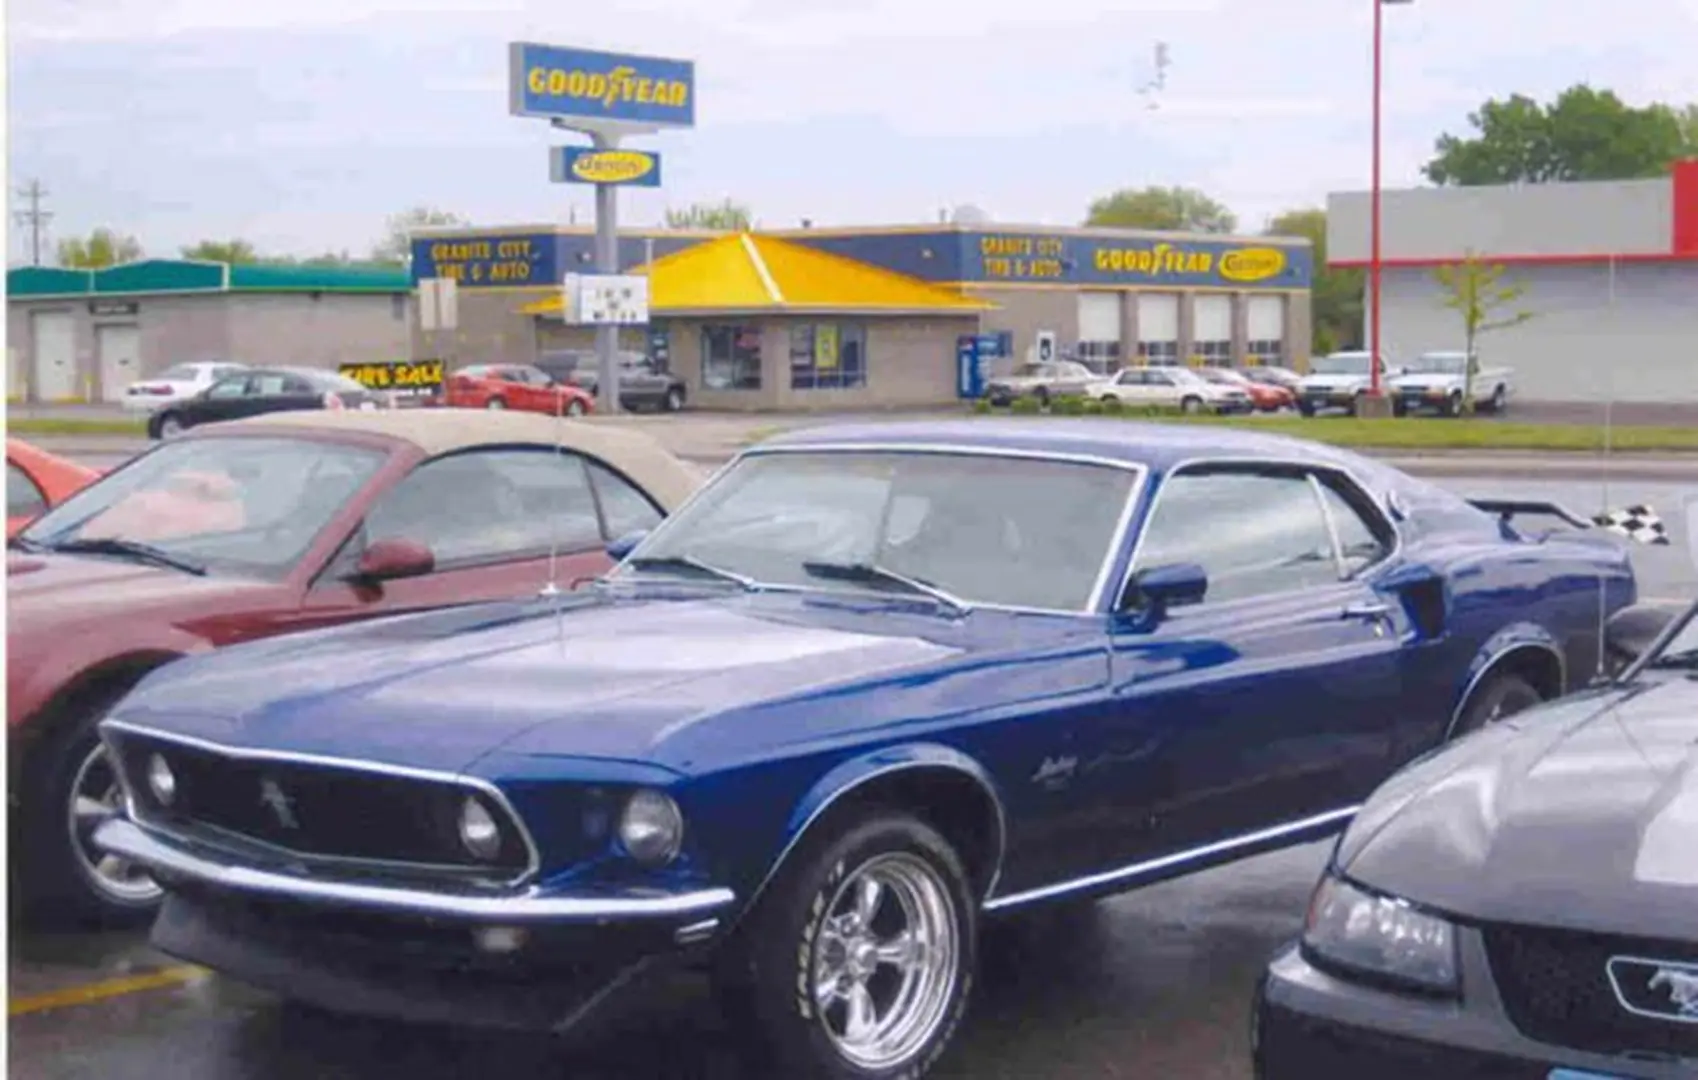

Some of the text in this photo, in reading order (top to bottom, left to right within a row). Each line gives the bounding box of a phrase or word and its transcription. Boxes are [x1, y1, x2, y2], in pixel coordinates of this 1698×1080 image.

[528, 66, 687, 108] GOODYEAR
[498, 240, 530, 258] CITY
[1096, 243, 1213, 276] GOODYEAR
